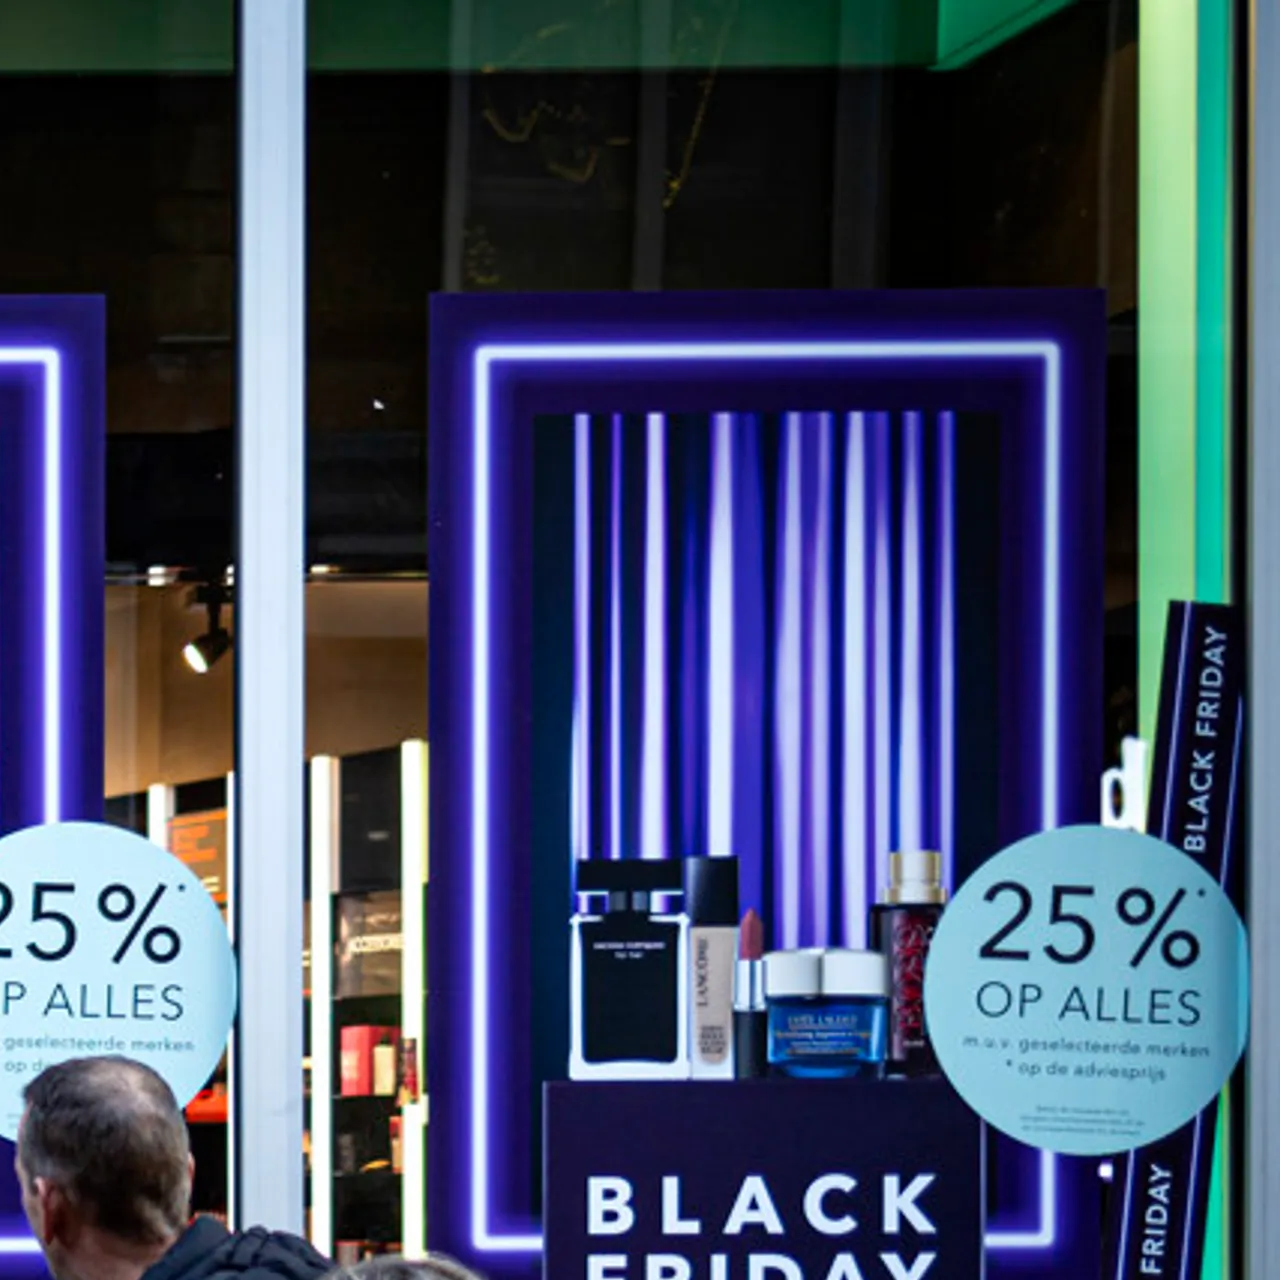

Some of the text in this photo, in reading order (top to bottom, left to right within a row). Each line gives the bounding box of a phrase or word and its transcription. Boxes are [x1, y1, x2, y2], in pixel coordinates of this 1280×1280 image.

[1183, 625, 1227, 852] BLACK FRIDAY
[42, 982, 184, 1022] ALLES
[976, 980, 1202, 1027] OP ALLES
[587, 1173, 937, 1235] BLACK
[1140, 1163, 1173, 1274] FRIDAY
